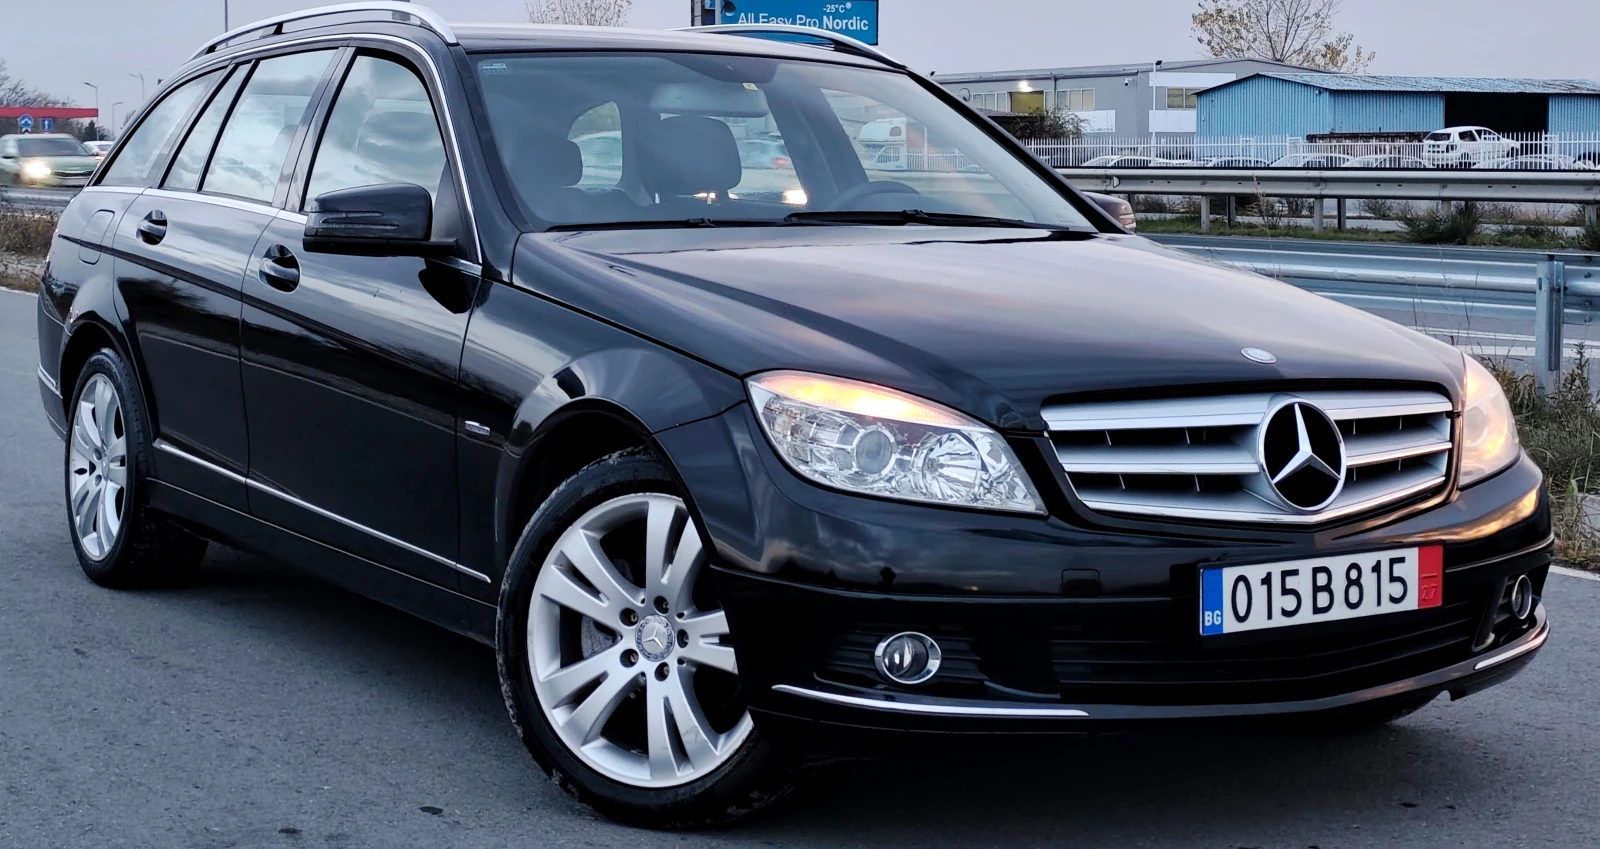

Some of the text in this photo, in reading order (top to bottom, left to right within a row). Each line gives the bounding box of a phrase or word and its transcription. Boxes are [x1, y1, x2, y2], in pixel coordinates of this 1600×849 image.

[738, 12, 754, 25] All
[797, 14, 819, 29] Pro
[823, 15, 869, 31] Nordic
[1231, 557, 1408, 623] 015B815
[1421, 584, 1438, 600] 27
[1204, 610, 1222, 627] BG
